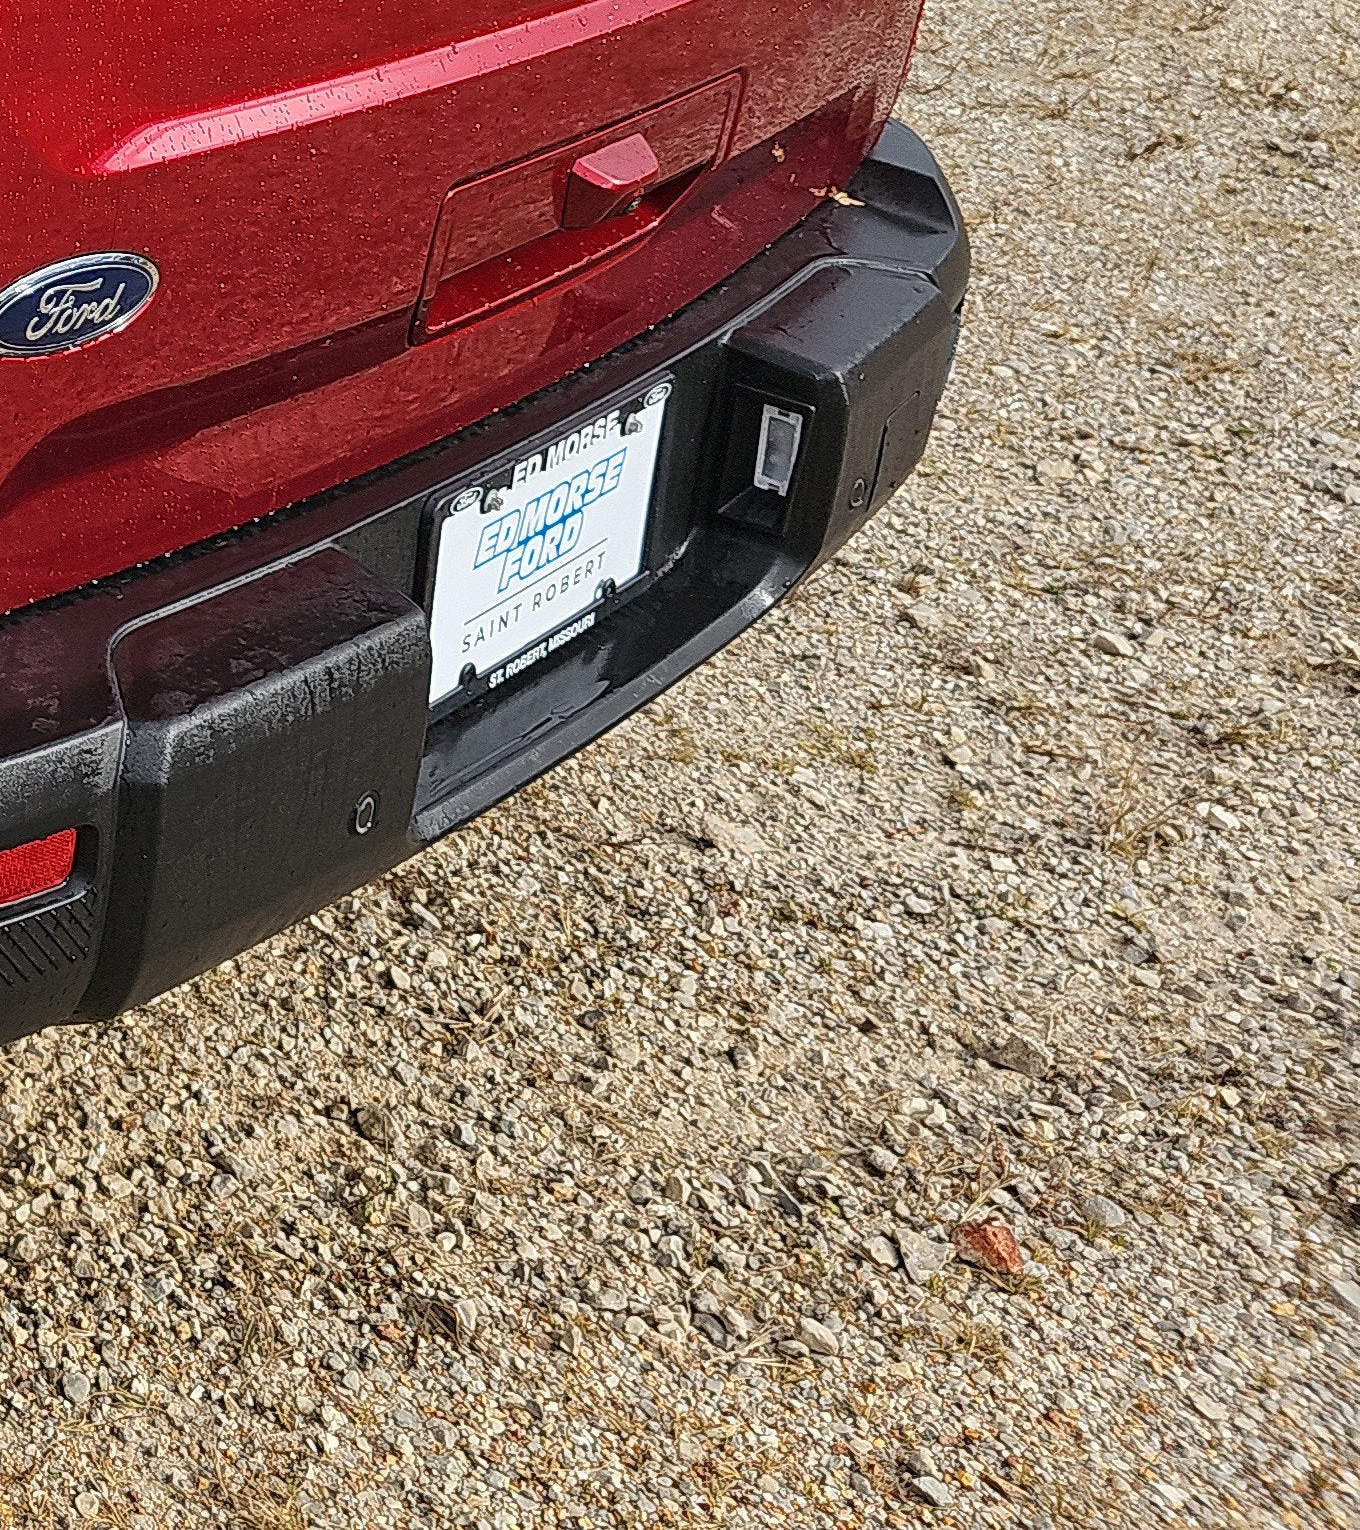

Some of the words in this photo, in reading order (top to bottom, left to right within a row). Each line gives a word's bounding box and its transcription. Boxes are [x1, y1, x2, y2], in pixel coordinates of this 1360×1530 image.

[25, 277, 126, 341] Ford
[512, 454, 543, 488] ED
[546, 410, 622, 470] MORSE
[473, 508, 522, 570] ED
[517, 446, 628, 545] MORSE
[498, 511, 584, 594] FORD
[461, 603, 523, 654] SAINT
[532, 551, 607, 612] ROBERT
[505, 641, 548, 680] ROBERT,
[547, 612, 596, 653] MISSOURI
